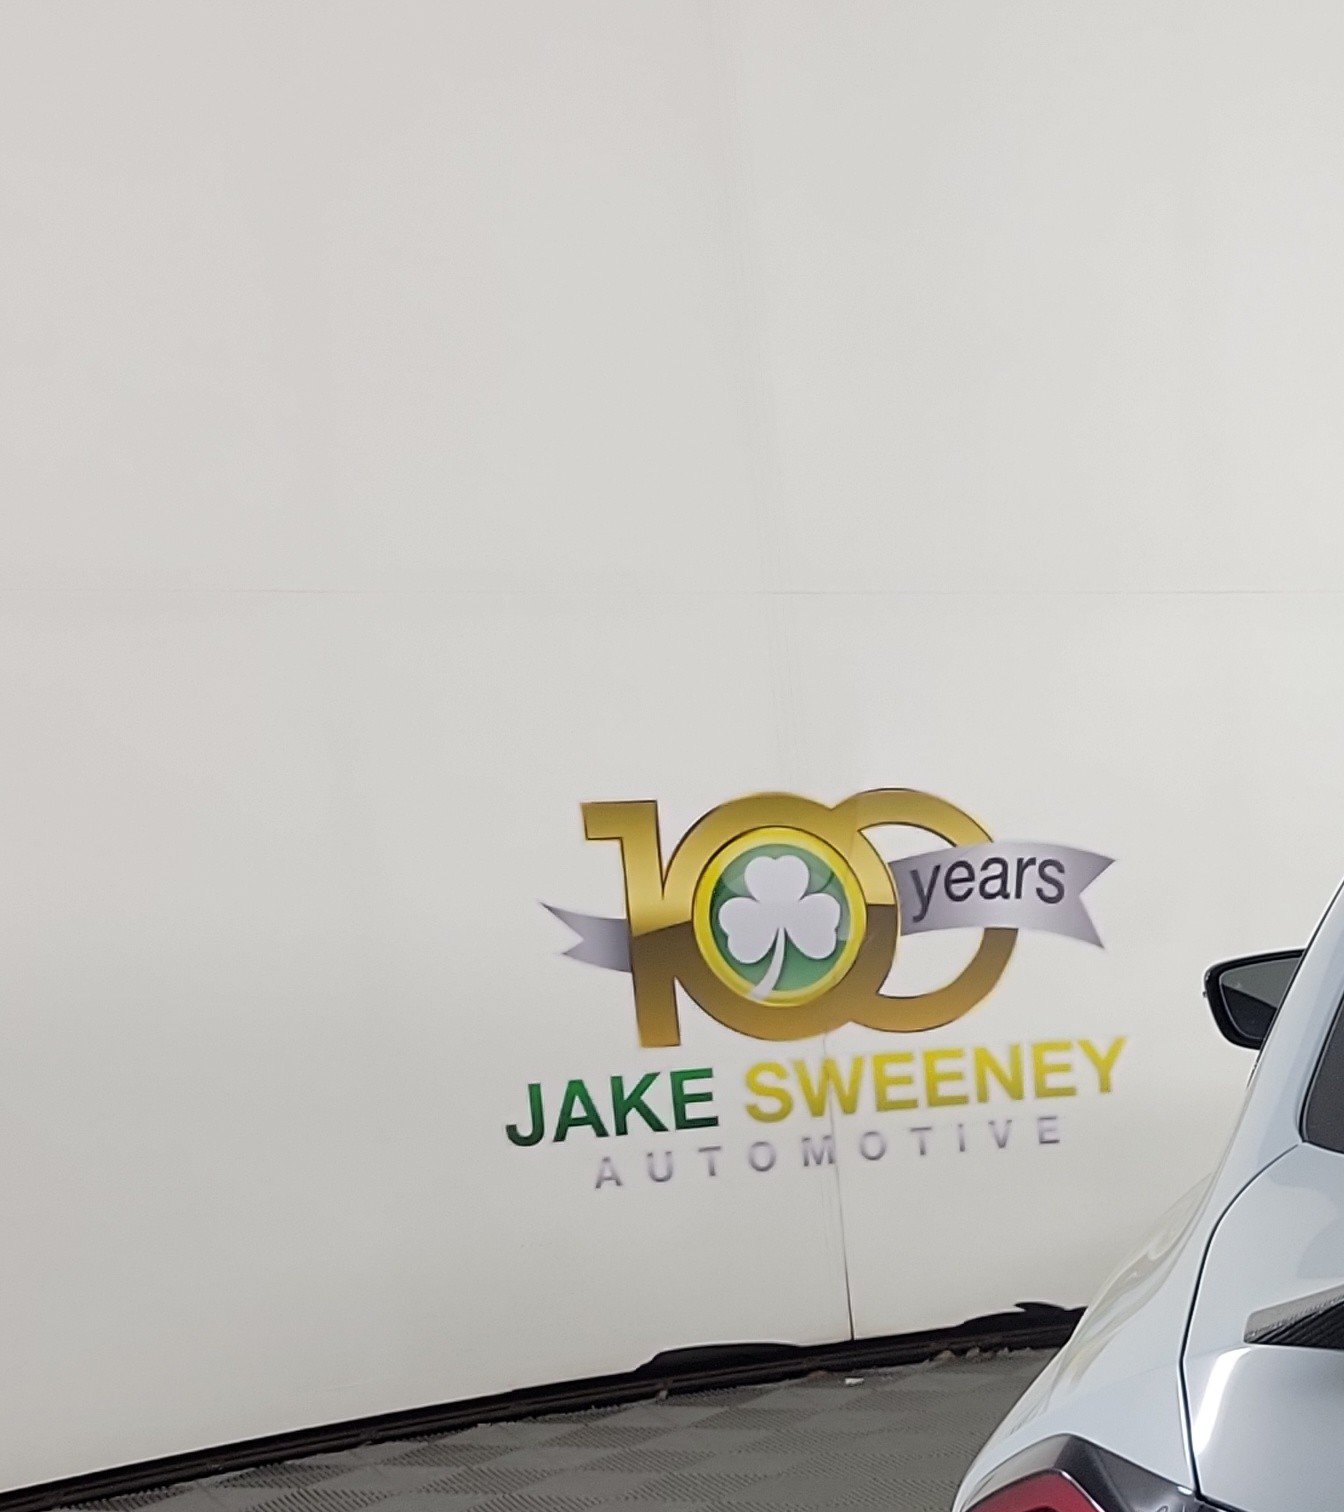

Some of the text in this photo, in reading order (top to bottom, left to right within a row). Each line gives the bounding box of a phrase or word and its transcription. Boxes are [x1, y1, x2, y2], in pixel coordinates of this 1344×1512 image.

[580, 787, 1066, 1048] 100 years
[505, 1036, 1127, 1148] JAKE SWEENEY
[594, 1115, 1062, 1190] AUTOMOTIVE
